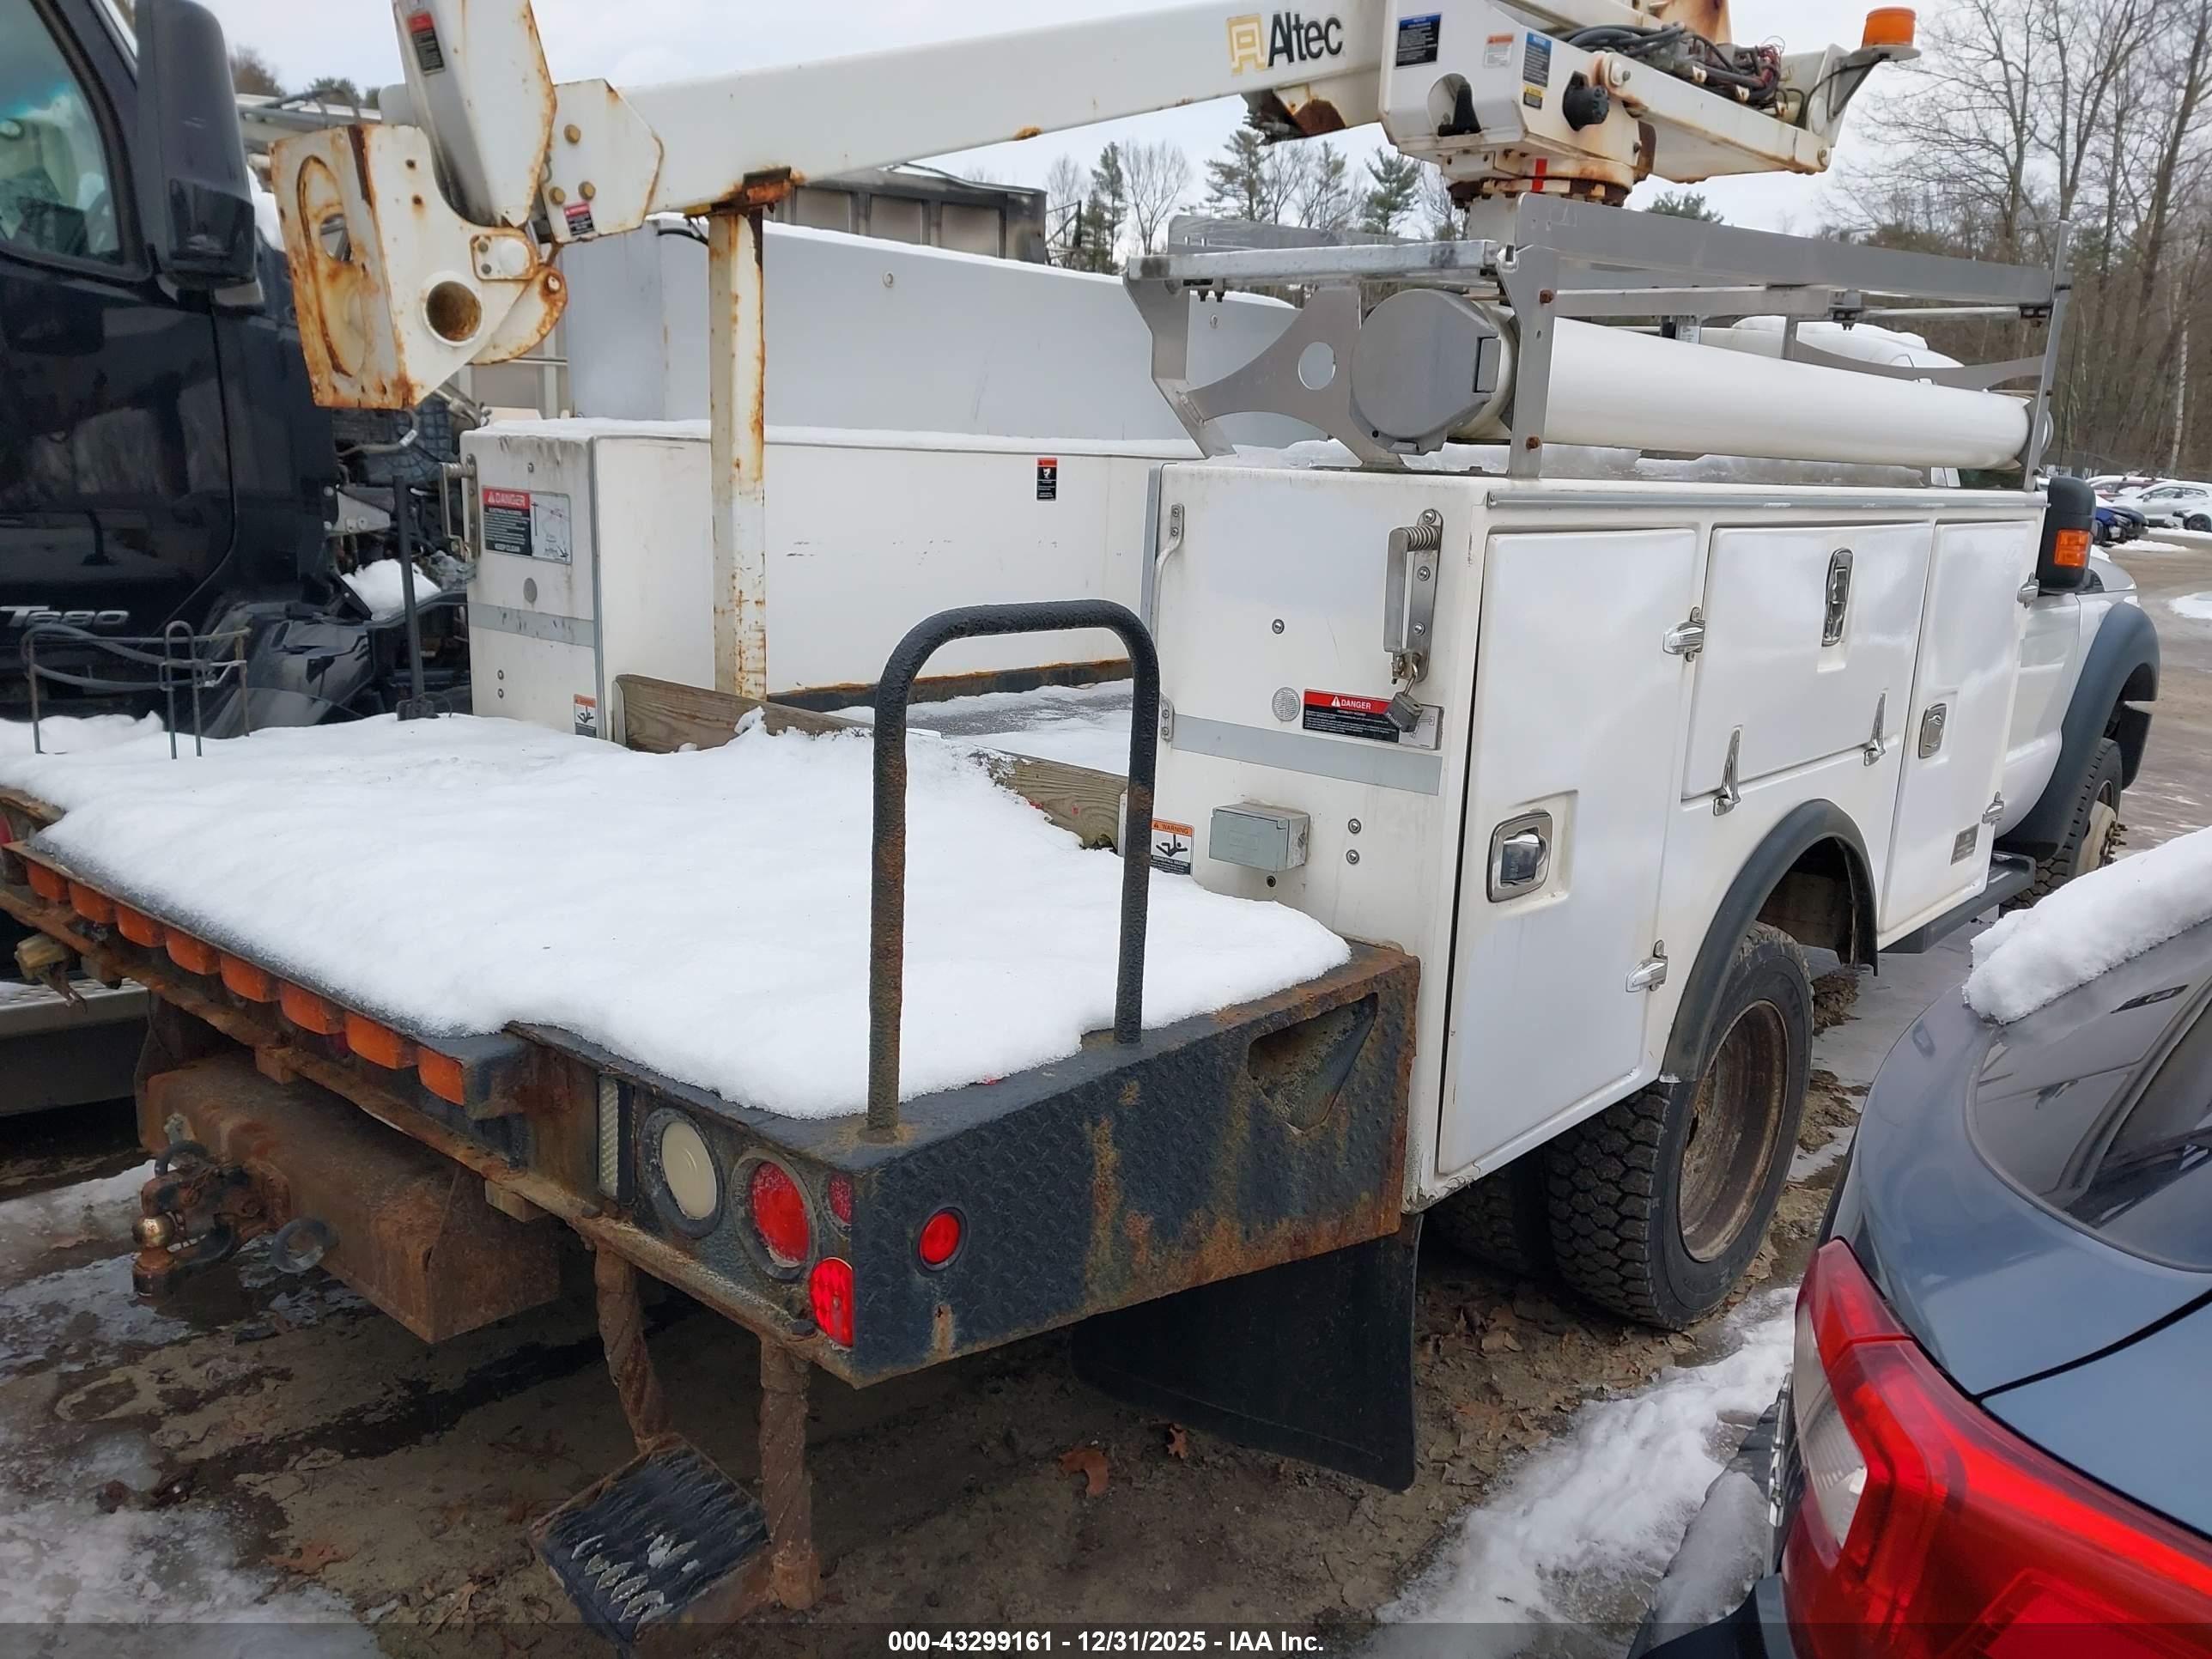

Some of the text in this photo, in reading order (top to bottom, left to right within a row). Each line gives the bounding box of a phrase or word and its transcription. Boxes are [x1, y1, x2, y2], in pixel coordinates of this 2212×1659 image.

[1267, 11, 1344, 68] Altec
[495, 492, 526, 507] DANGER
[0, 605, 129, 628] T680
[1341, 699, 1371, 710] DANGER
[1162, 823, 1188, 835] WARNING
